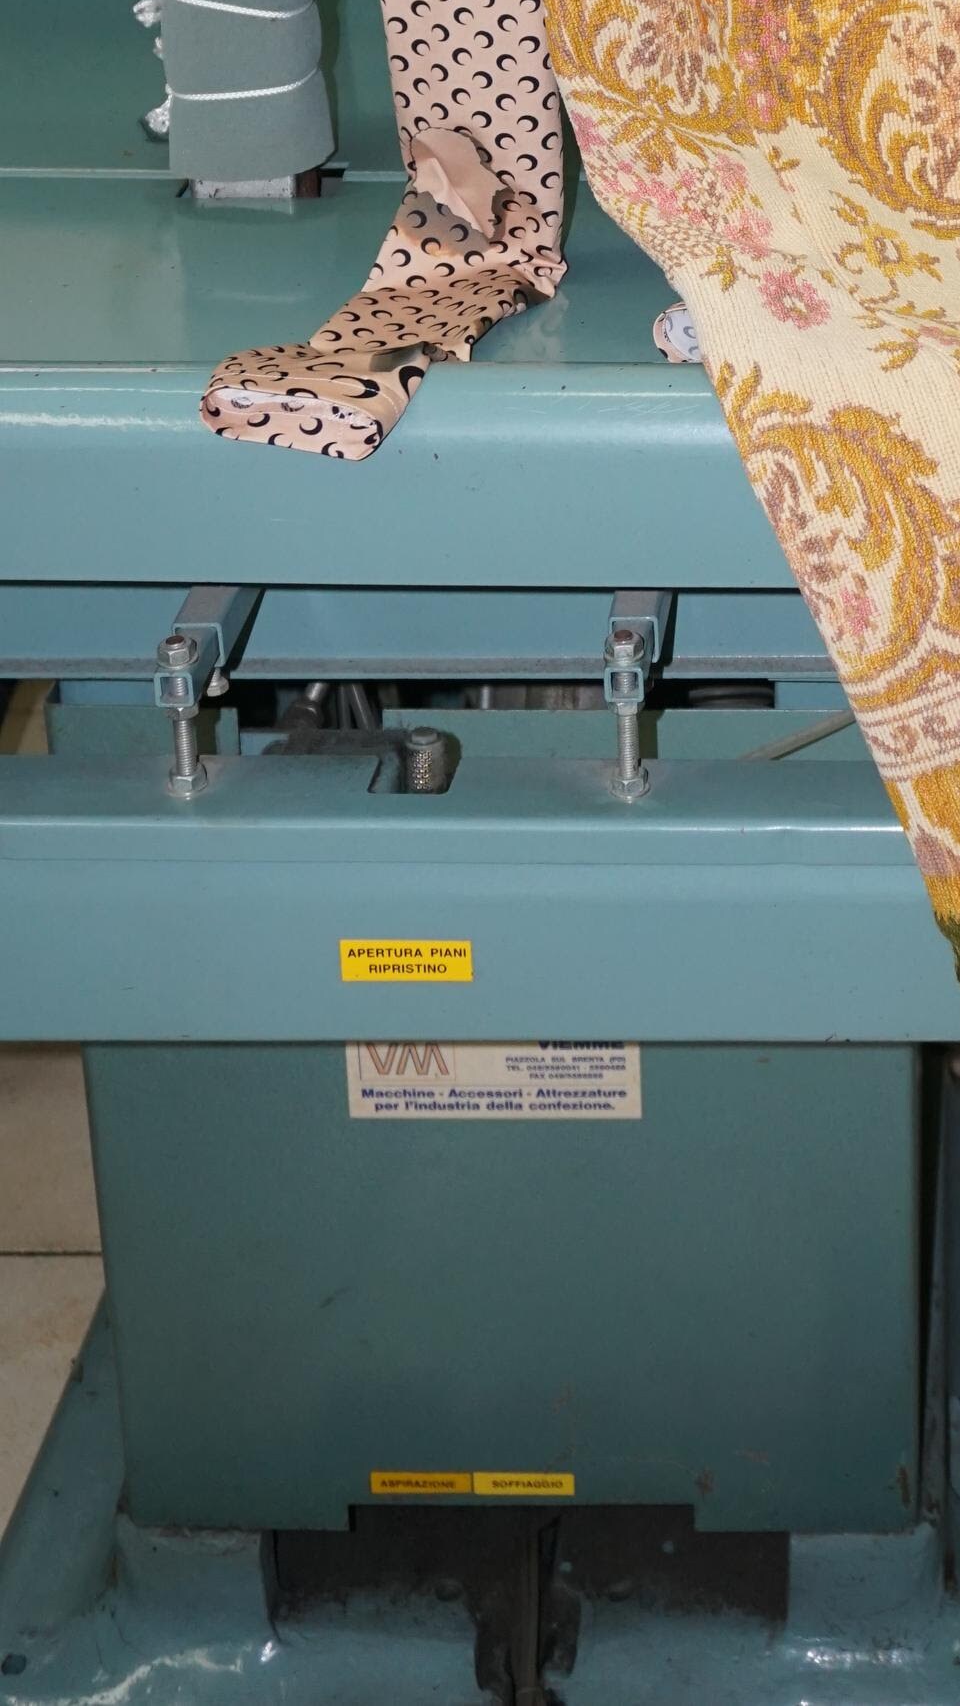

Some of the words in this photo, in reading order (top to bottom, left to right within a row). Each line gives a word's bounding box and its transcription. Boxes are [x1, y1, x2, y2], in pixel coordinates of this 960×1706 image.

[347, 948, 423, 958] APERTURA
[430, 948, 467, 958] PIANI
[368, 964, 448, 974] RIPRISTINO
[361, 1089, 435, 1099] Macchine
[448, 1089, 524, 1099] Accessori
[536, 1089, 627, 1099] Attrezzature
[375, 1102, 399, 1112] per
[405, 1101, 481, 1111] l'industria
[486, 1101, 524, 1111] della
[529, 1101, 616, 1111] confezione.
[380, 1479, 457, 1489] ASPIRAZIONE
[491, 1479, 564, 1489] SOFFIAGGIO
